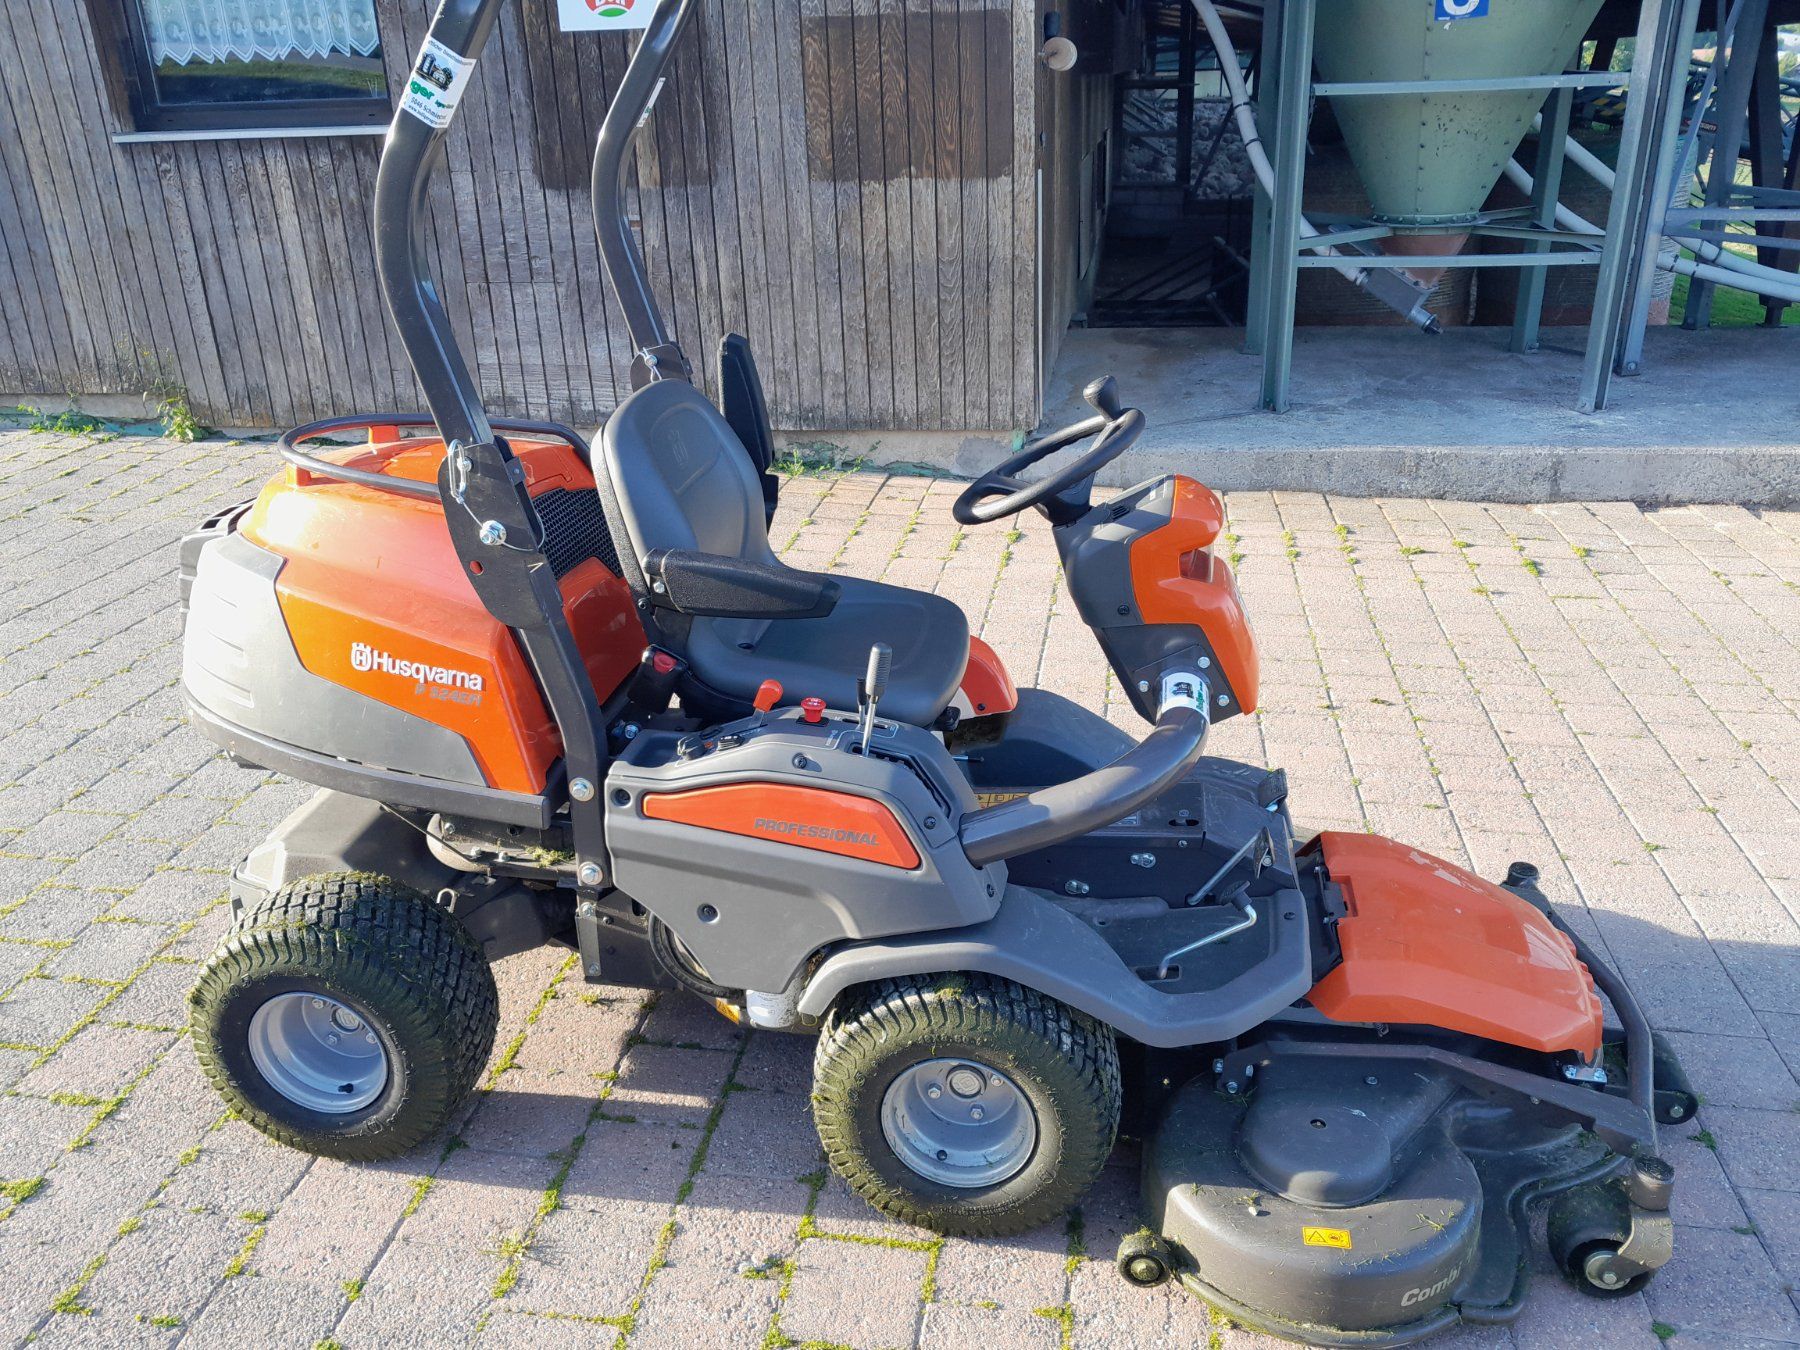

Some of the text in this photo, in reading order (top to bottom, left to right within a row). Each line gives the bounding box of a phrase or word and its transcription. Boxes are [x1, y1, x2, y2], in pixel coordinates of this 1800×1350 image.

[372, 650, 483, 691] Husqvarna
[754, 817, 880, 846] PROFESSIONAL
[1400, 1261, 1463, 1307] Combi
